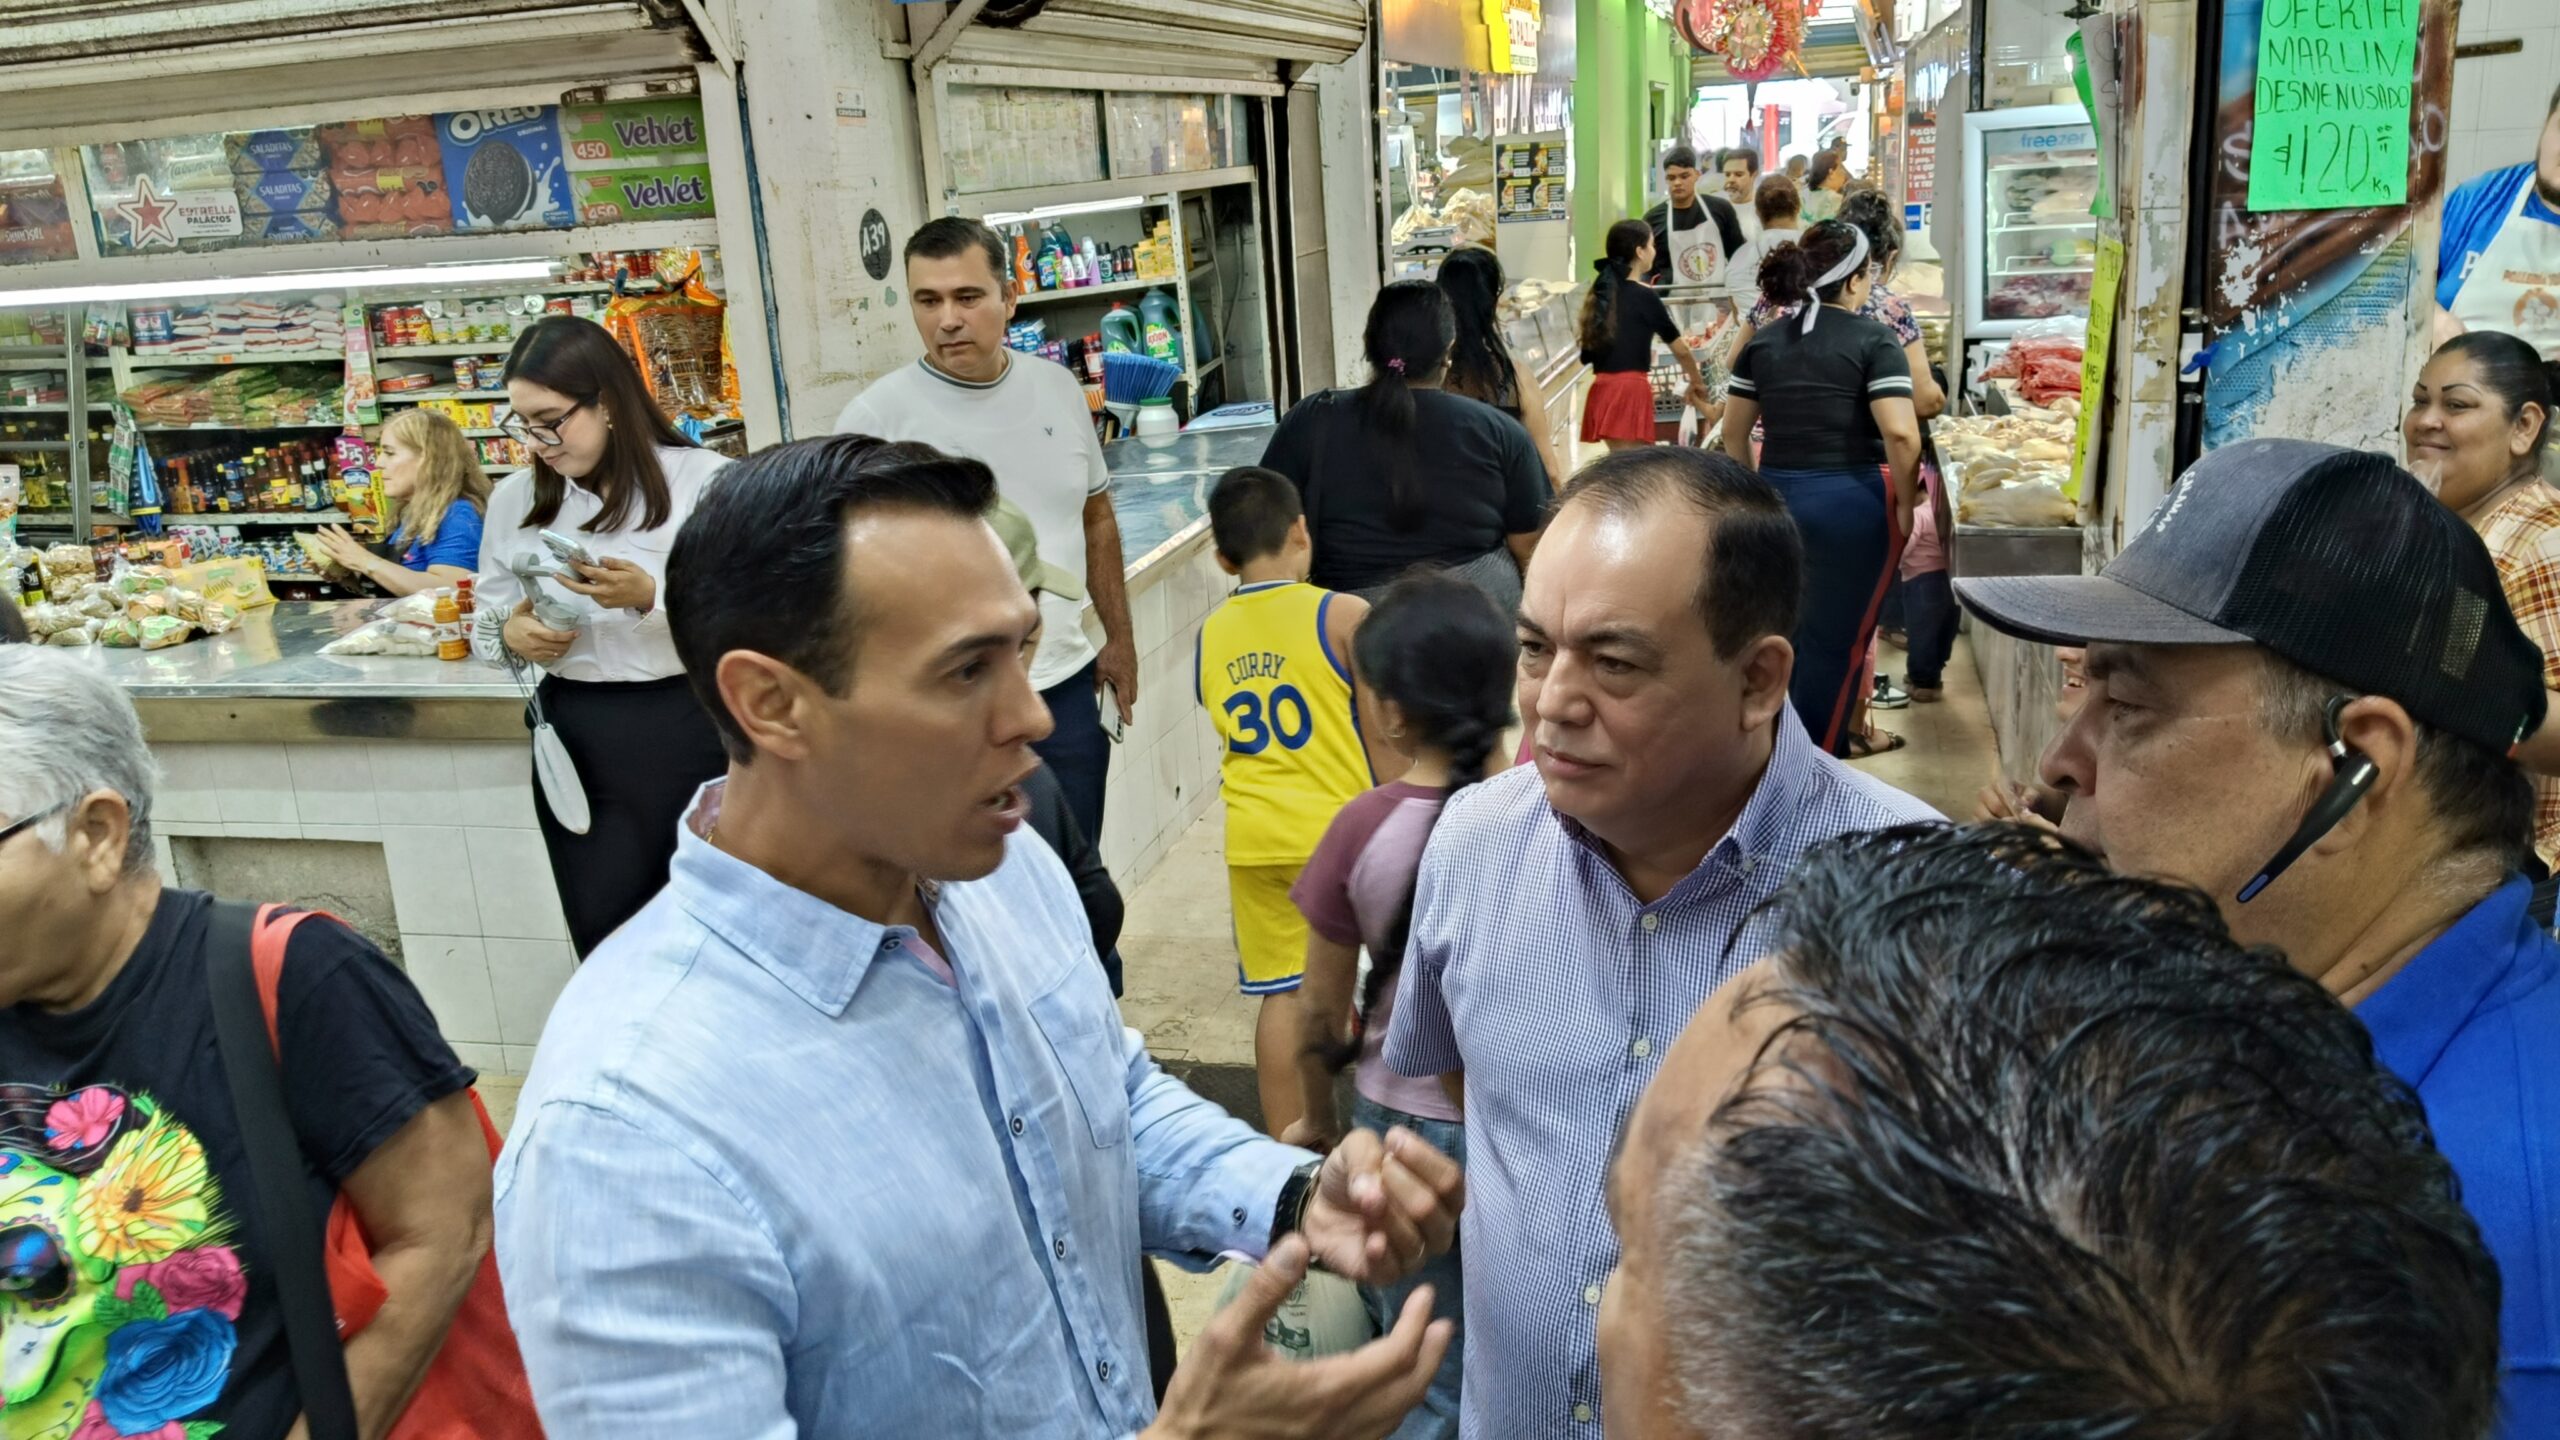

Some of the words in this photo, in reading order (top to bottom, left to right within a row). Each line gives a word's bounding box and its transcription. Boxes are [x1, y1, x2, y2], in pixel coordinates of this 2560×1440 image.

[2268, 36, 2405, 77] MARLIN
[2257, 76, 2410, 114] DESMENUSADO
[450, 105, 543, 140] OREO
[613, 114, 697, 149] Velvet
[2021, 131, 2088, 148] freezer
[250, 142, 293, 154] SALADITAS
[576, 142, 607, 158] 450
[259, 183, 303, 196] SALADITAS
[621, 175, 708, 210] Velvet
[178, 204, 237, 217] ESTRELLA
[186, 215, 232, 225] PALACIOS
[862, 222, 886, 257] A39
[1226, 651, 1286, 685] CURRY
[1222, 683, 1313, 755] 30
